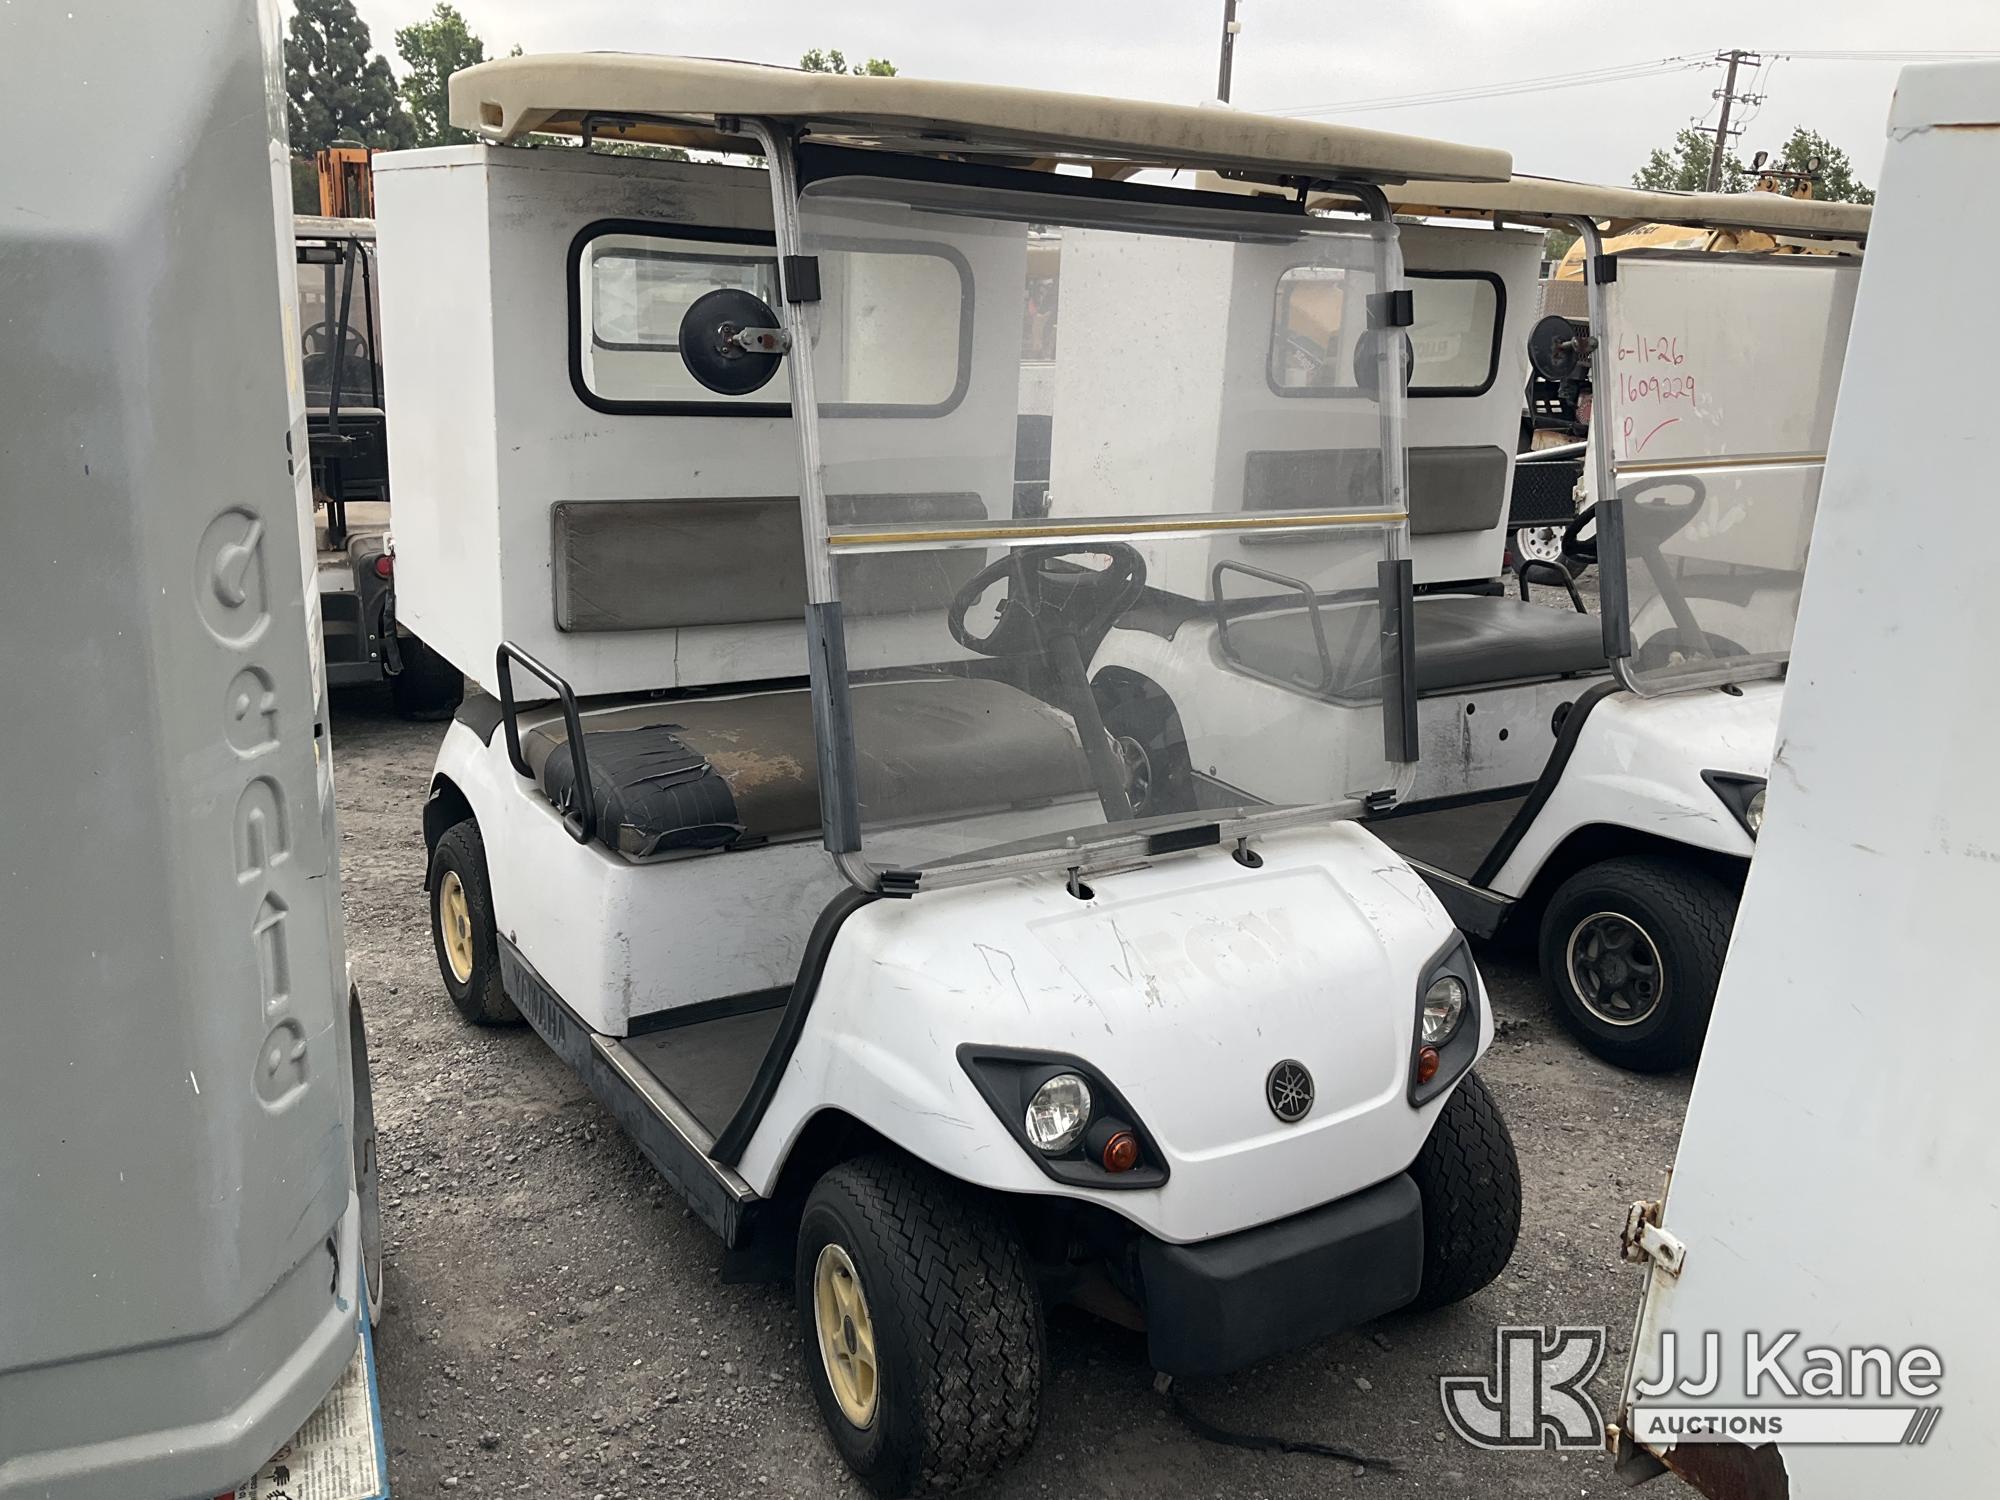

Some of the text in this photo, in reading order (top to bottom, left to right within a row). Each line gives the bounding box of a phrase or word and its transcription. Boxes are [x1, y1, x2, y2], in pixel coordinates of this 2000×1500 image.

[1618, 333, 1684, 365] 6-11-26
[1620, 373, 1695, 407] 1609229
[513, 964, 566, 1048] YAMAHA
